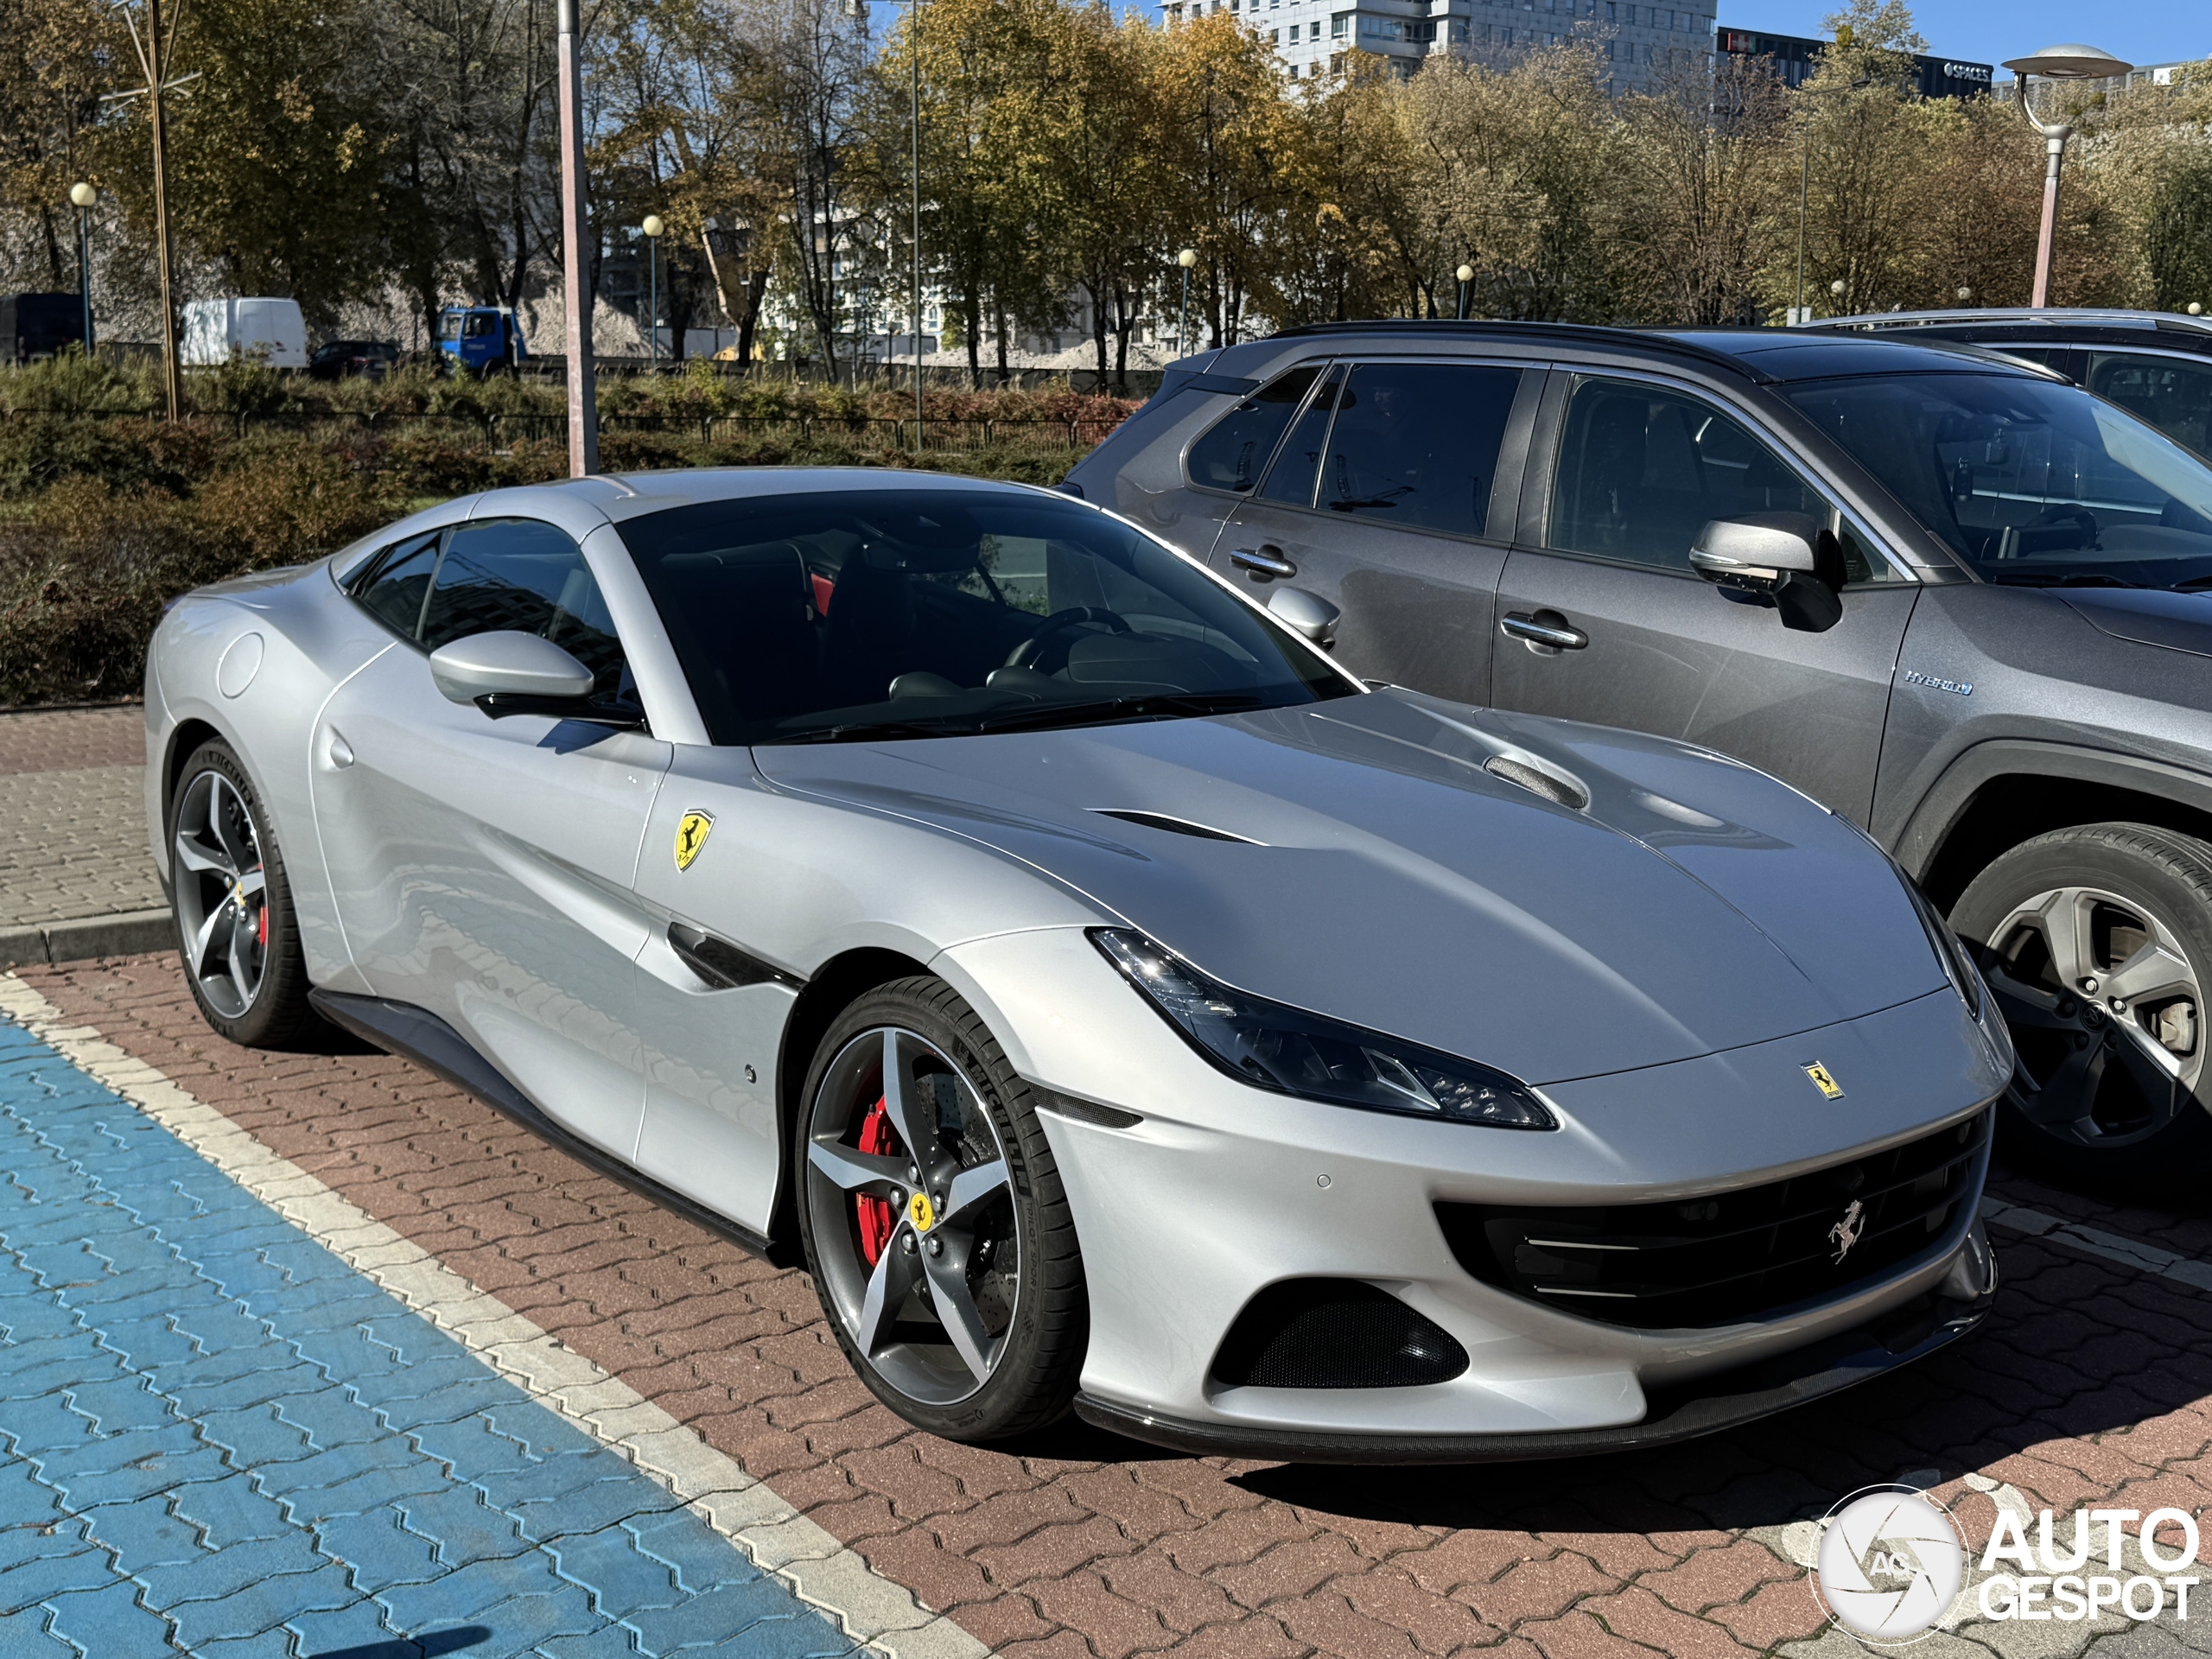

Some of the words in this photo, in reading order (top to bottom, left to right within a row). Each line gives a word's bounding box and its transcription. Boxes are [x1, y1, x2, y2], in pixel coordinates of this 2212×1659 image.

[1905, 671, 1961, 694] HYBRID
[212, 753, 251, 801] MICHELIN
[969, 1063, 1029, 1190] MICHELIN
[1027, 1207, 1036, 1245] PILOT
